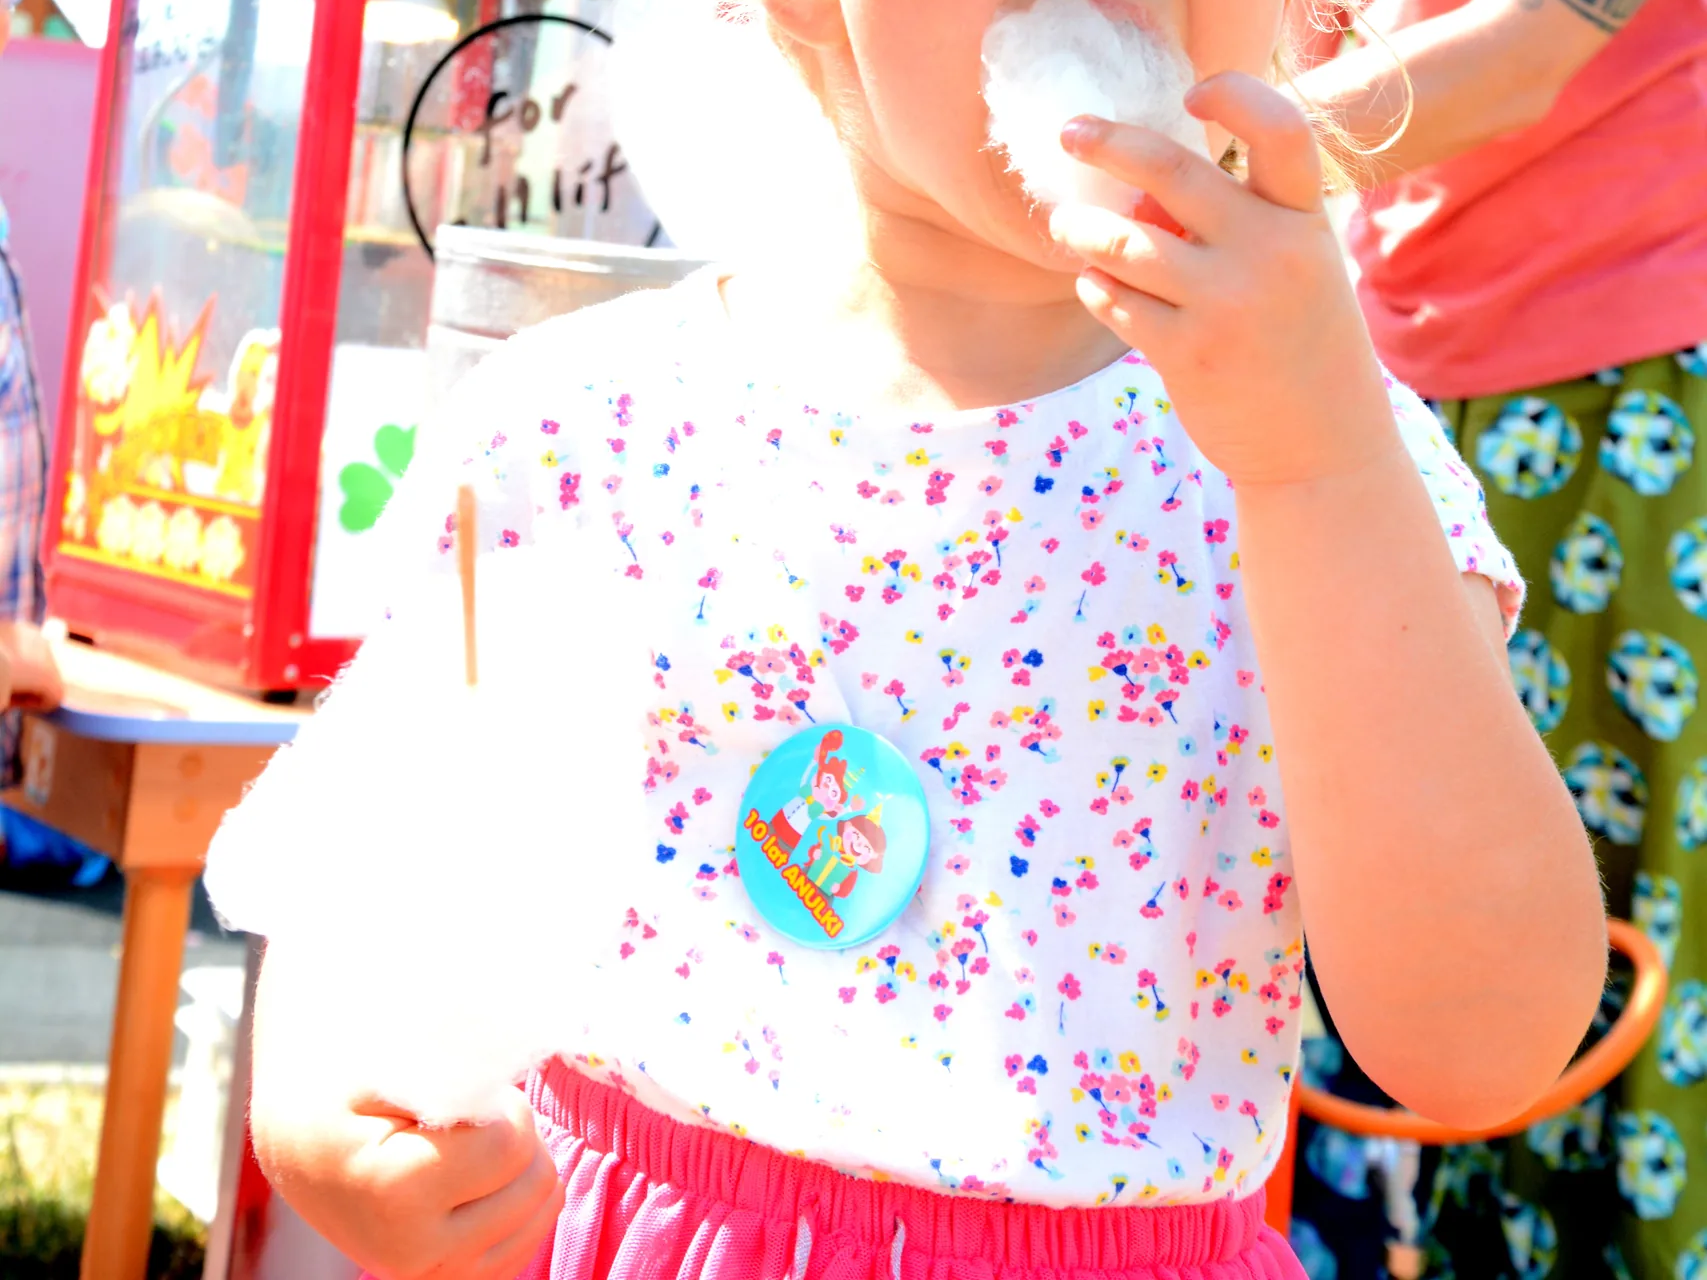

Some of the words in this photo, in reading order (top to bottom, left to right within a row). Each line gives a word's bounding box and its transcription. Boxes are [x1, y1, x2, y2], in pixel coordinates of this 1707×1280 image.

[476, 83, 579, 167] for
[552, 141, 627, 214] lif
[744, 808, 768, 841] 10
[761, 835, 790, 869] lat
[782, 863, 844, 938] ANULKI
